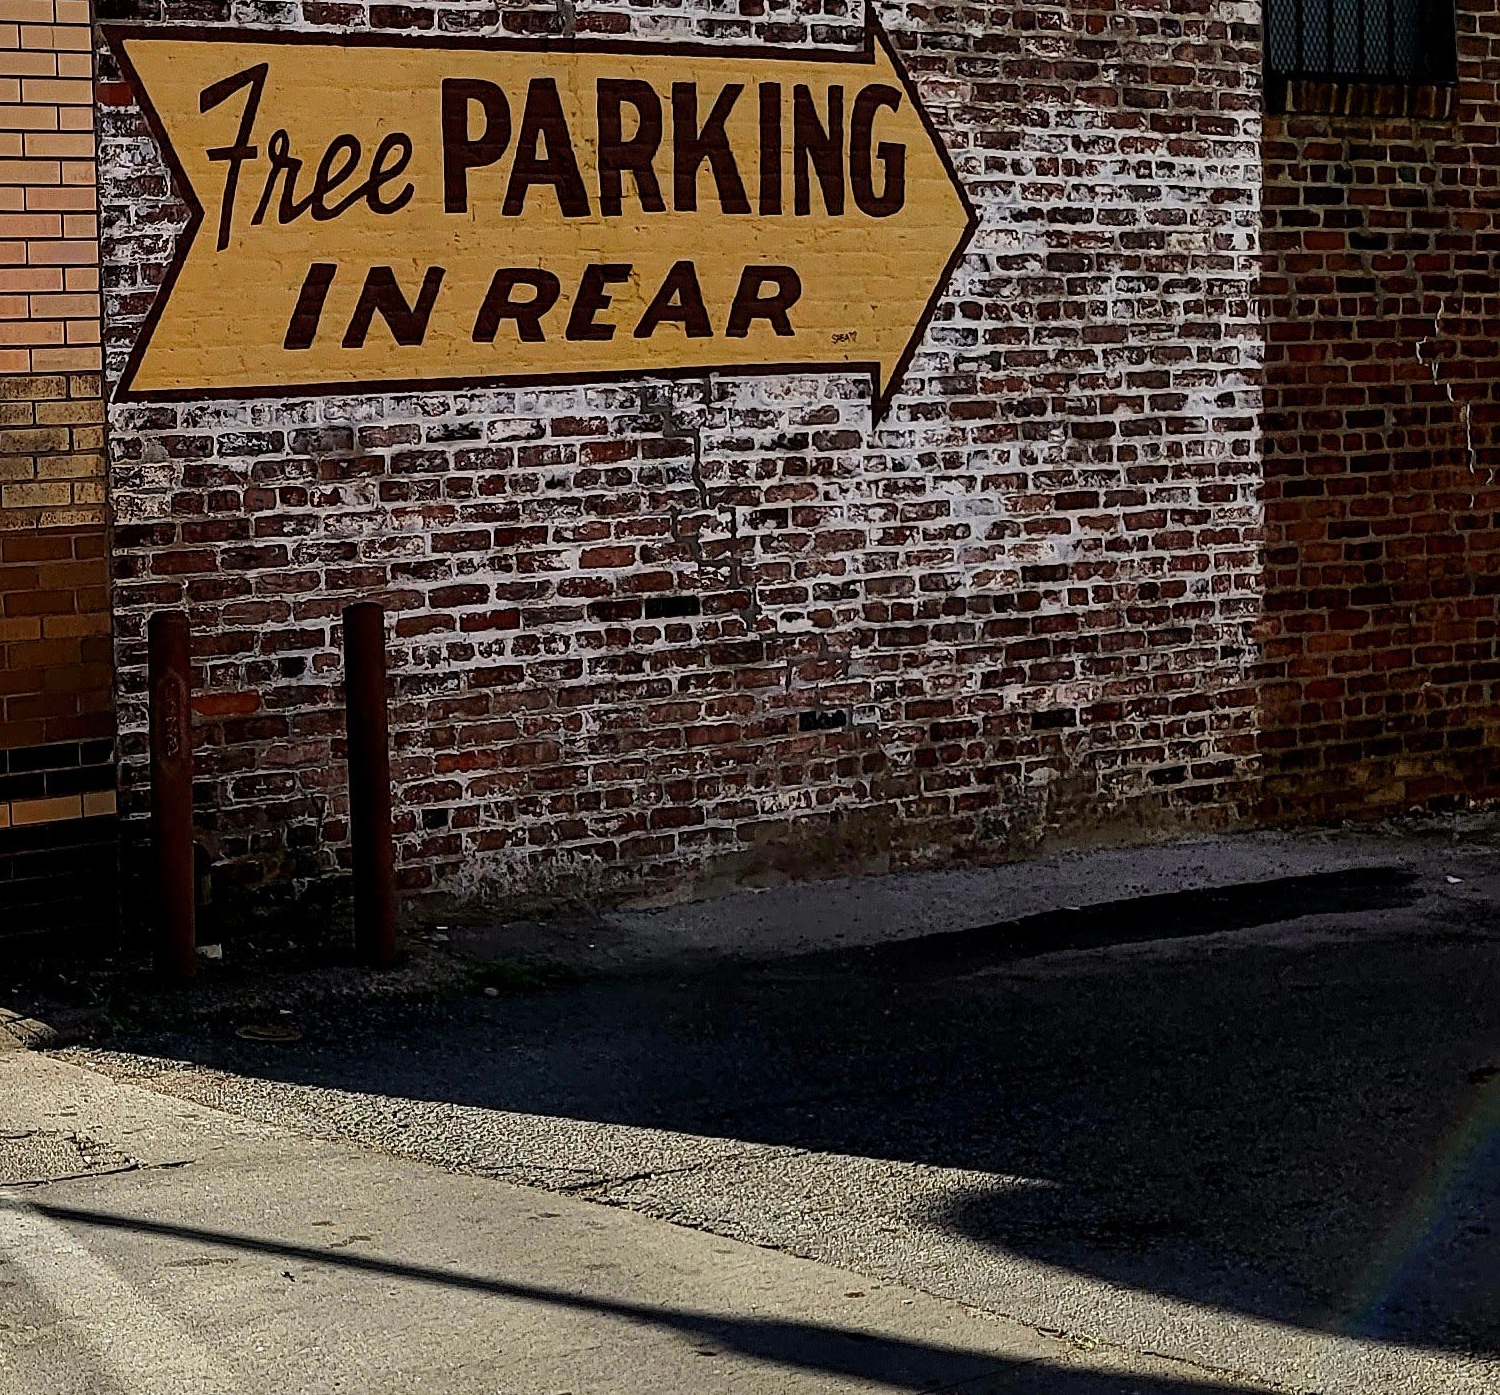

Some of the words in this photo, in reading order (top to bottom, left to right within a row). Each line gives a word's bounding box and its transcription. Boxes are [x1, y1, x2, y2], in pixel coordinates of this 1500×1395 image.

[199, 62, 415, 252] Free
[441, 76, 907, 219] PARKING
[284, 262, 446, 350] IN
[471, 259, 803, 344] REAR
